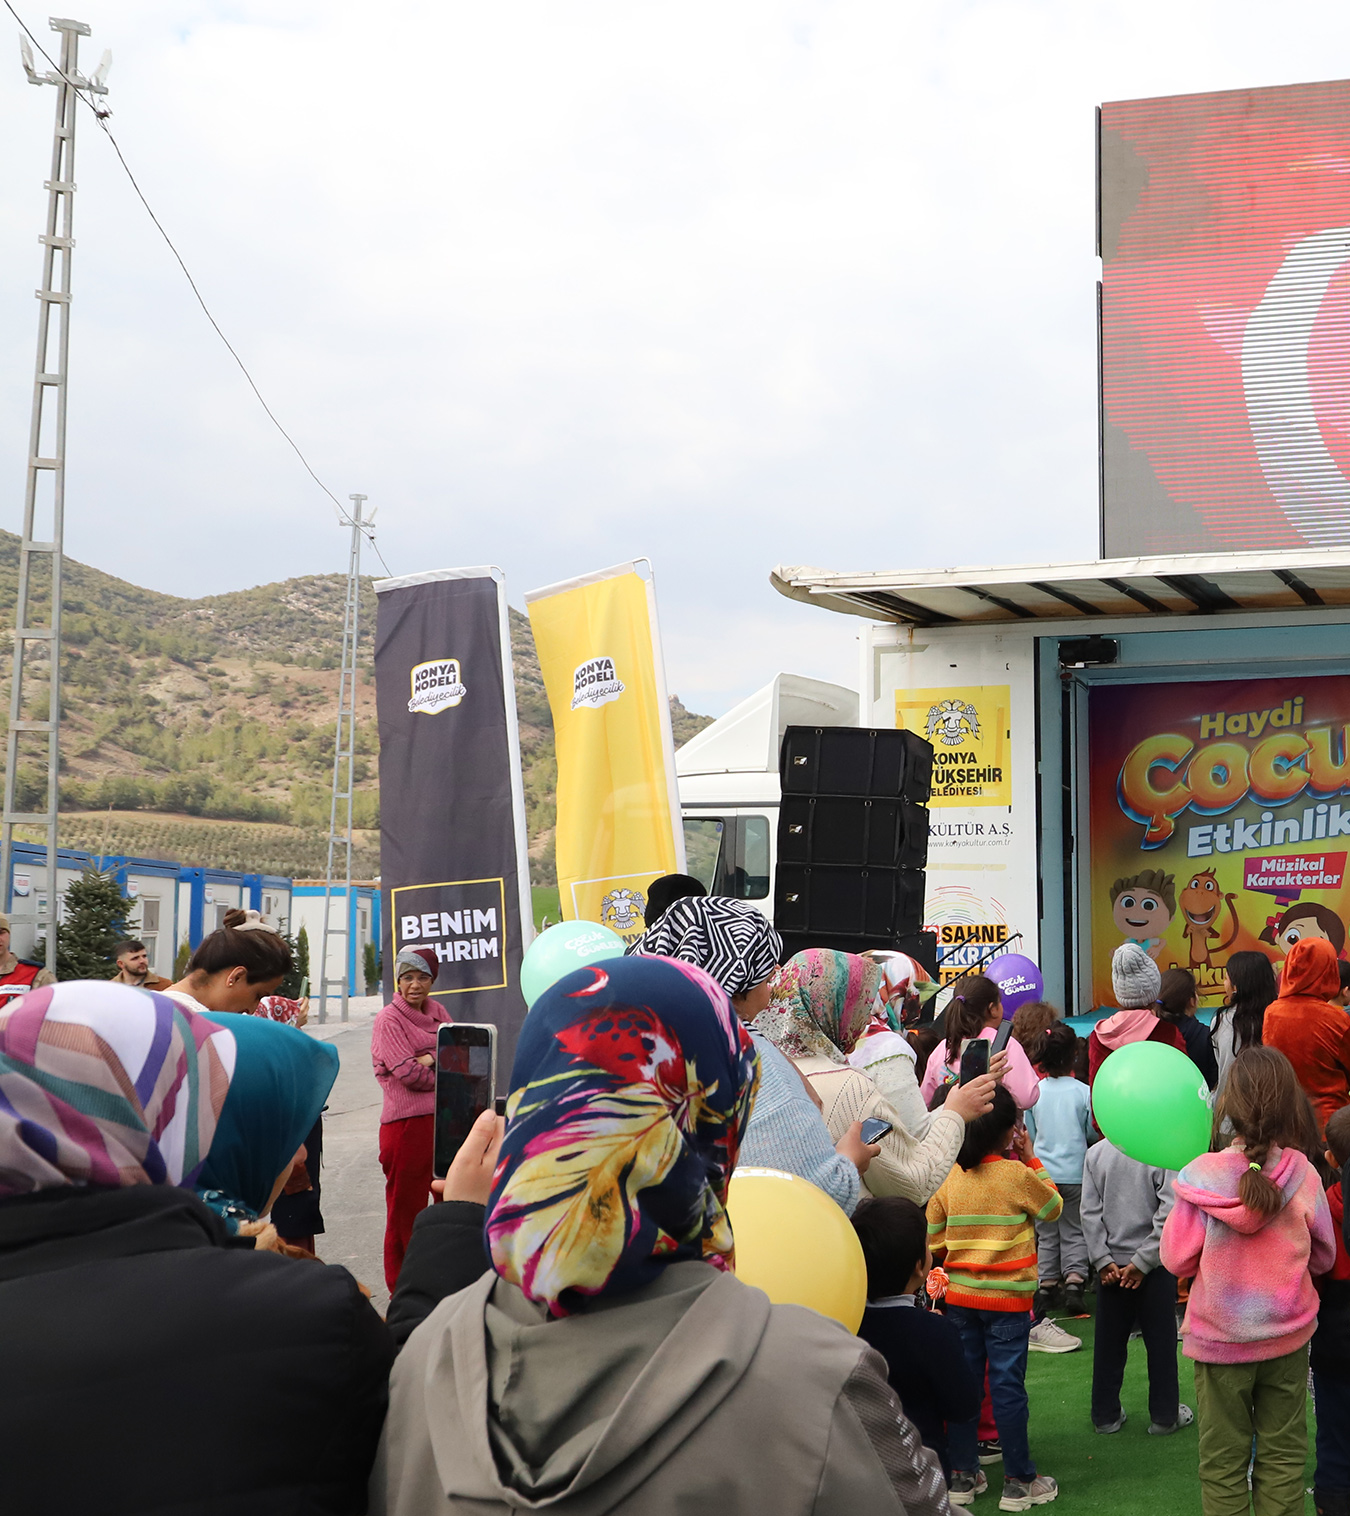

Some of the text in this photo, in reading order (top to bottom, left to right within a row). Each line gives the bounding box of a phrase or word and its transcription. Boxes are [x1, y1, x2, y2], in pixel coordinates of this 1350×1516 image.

[415, 663, 457, 683] KONYA
[576, 659, 613, 683] KONYA
[1200, 696, 1304, 738] Haydi
[930, 784, 982, 796] ELEDİYESİ
[988, 823, 1013, 837] A.Ş.
[1261, 857, 1325, 872] Müzikal
[1246, 872, 1340, 887] Karakterler
[942, 925, 1007, 943] SAHNE
